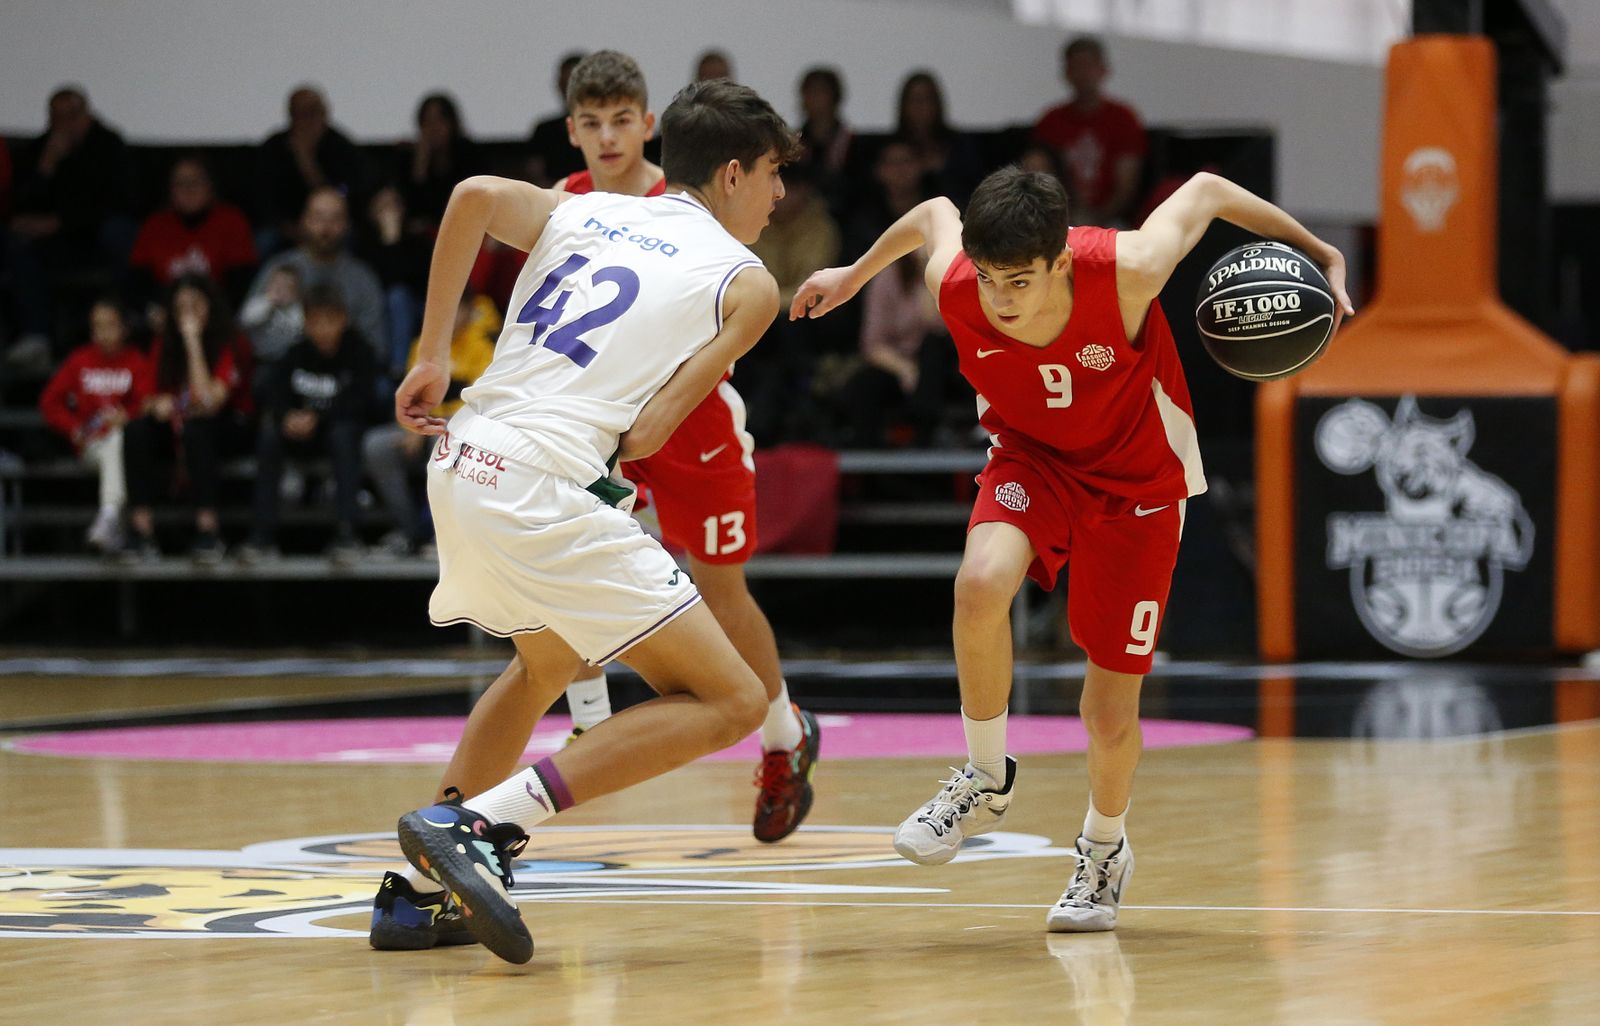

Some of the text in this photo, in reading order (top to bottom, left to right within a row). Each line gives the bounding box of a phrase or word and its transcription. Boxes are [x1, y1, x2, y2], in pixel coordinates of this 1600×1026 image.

[1208, 257, 1302, 292] SPALDING
[516, 252, 641, 369] 42
[1213, 293, 1301, 319] TF-1000
[1238, 312, 1274, 325] LEGACY
[1242, 322, 1268, 331] CHANNEL
[1269, 319, 1290, 327] DESIGN
[1082, 355, 1116, 368] GIRONA
[1038, 364, 1072, 409] 9
[476, 450, 506, 472] SOL
[702, 510, 747, 556] 13
[1125, 600, 1160, 657] 9
